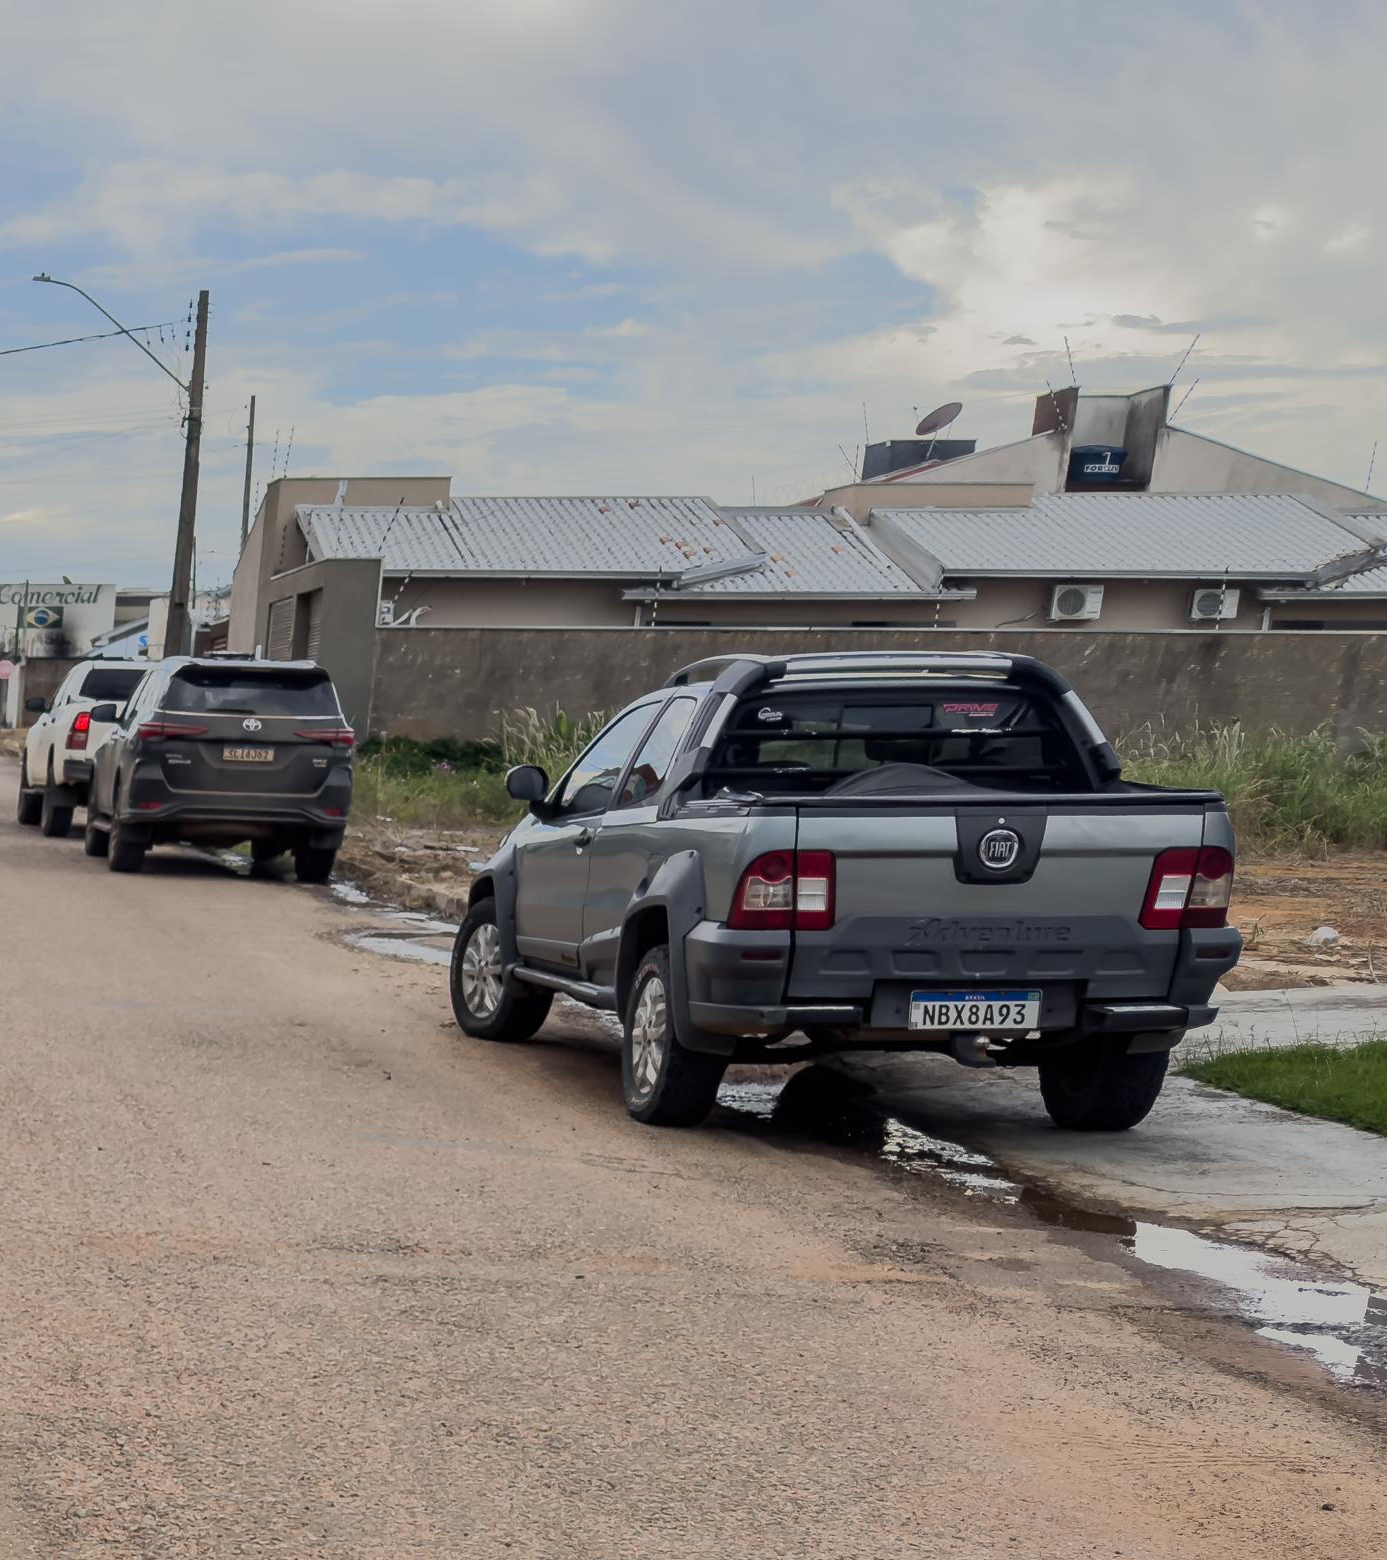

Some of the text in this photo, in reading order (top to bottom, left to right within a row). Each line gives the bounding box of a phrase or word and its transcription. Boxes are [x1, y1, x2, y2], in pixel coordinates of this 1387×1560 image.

[988, 841, 1012, 858] FIAT
[905, 918, 1072, 946] Adventure
[922, 1004, 1026, 1026] NBX8A93
